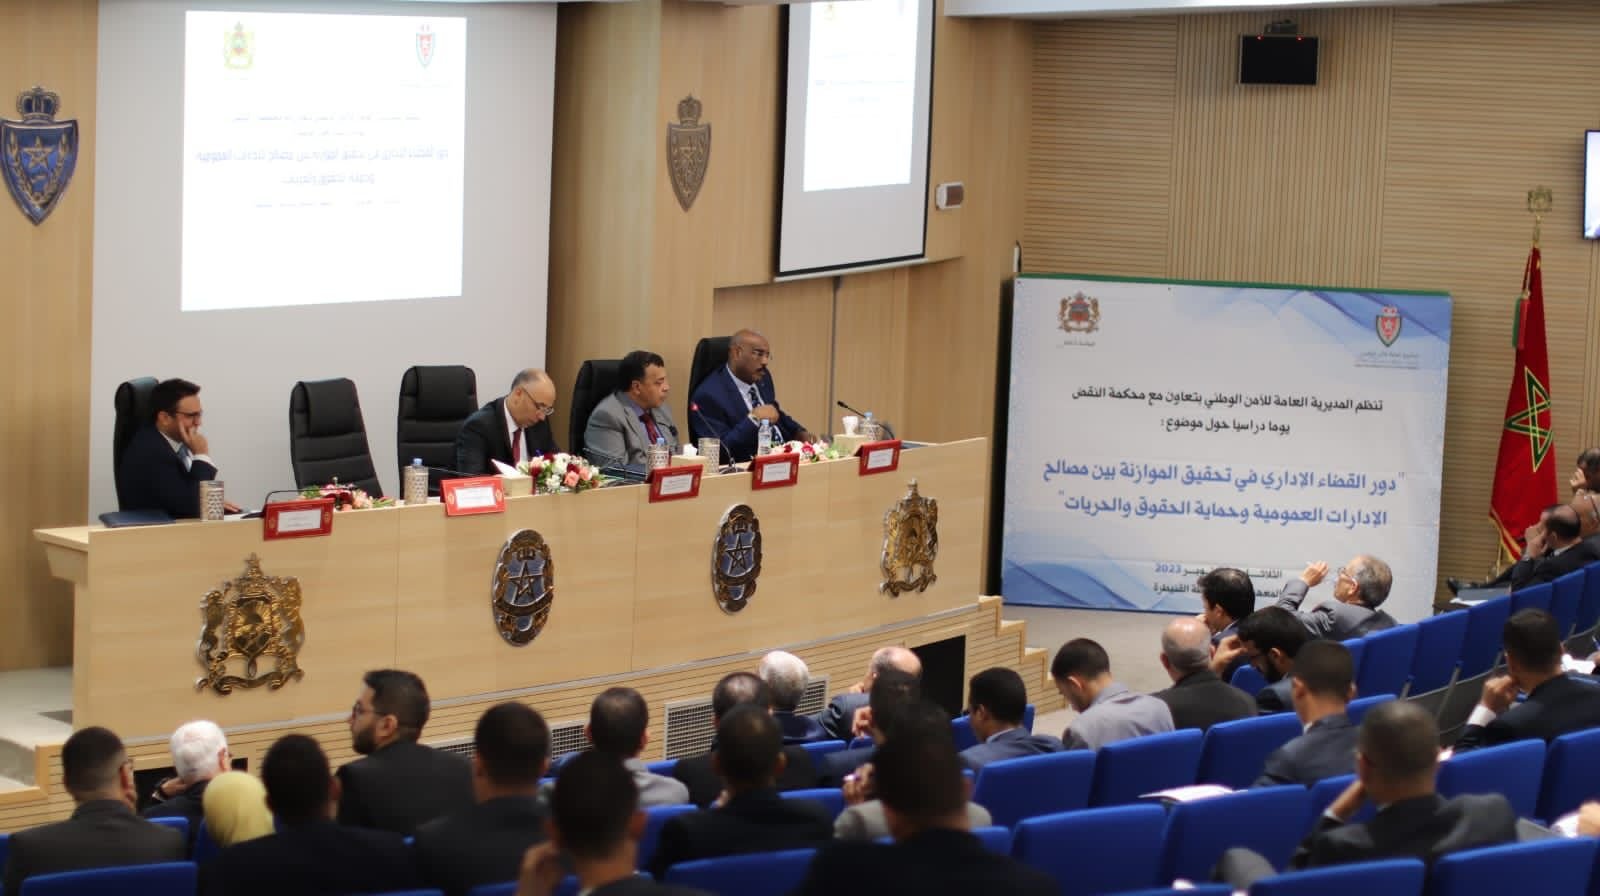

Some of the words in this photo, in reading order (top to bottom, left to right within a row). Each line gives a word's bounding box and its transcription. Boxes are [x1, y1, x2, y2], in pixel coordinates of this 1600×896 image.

[1072, 385, 1106, 400] النقض
[1108, 387, 1146, 400] محكمة
[1148, 391, 1163, 406] مع
[1165, 391, 1202, 405] بتعاون
[1204, 393, 1242, 408] الوطني
[1273, 395, 1308, 408] العامة
[1310, 396, 1353, 412] المديرية
[1355, 399, 1383, 414] تنظم
[1205, 418, 1230, 432] حول
[1268, 420, 1290, 435] يوما
[1042, 459, 1089, 482] مصالح
[1092, 465, 1116, 480] بين
[1119, 462, 1178, 484] الموازنة
[1181, 465, 1232, 485] تحقيق
[1235, 469, 1258, 492] في
[1261, 470, 1314, 491] الإداري
[1318, 473, 1366, 489] القضاء
[1135, 496, 1191, 519] الحقوق
[1194, 500, 1249, 524] وحماية
[1253, 503, 1323, 526] العمومية
[1326, 508, 1388, 529] الإدارات
